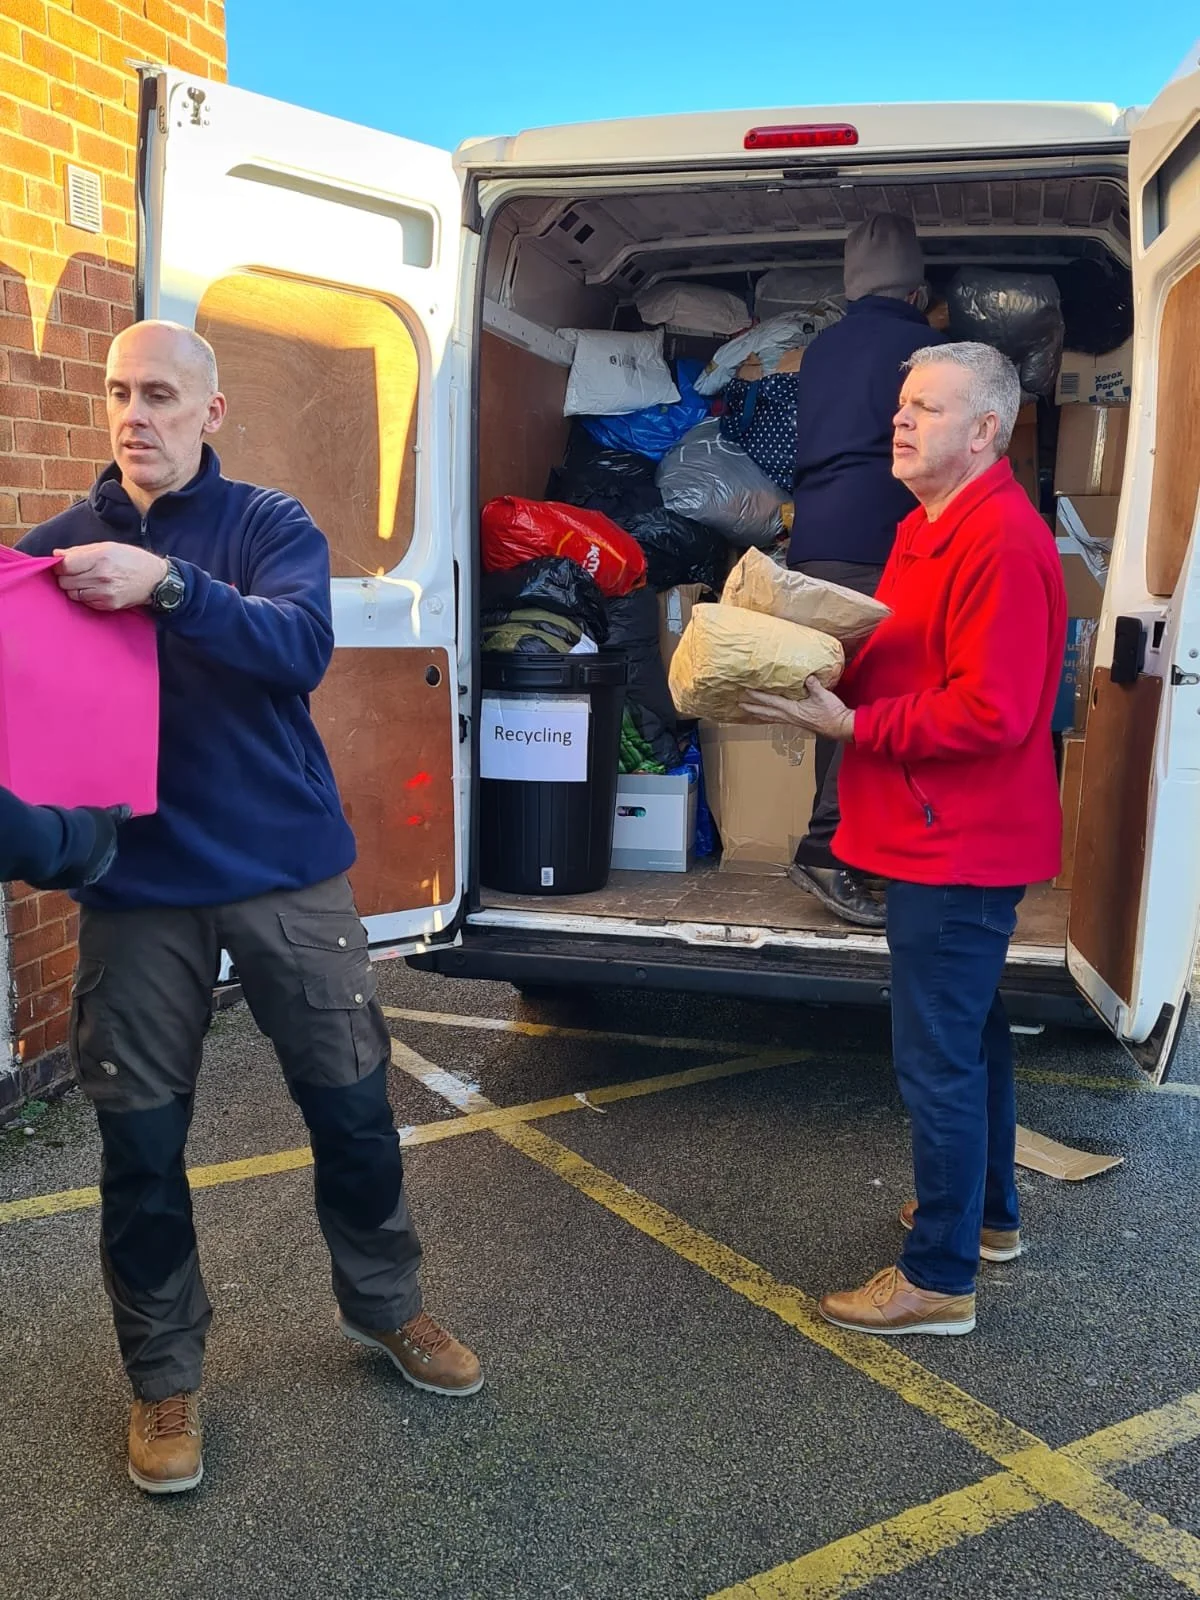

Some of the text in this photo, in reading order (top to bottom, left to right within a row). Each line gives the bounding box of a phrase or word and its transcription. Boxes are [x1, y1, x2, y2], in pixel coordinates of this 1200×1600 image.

[1095, 371, 1122, 384] Xerox
[1095, 379, 1124, 391] Paper
[494, 725, 572, 747] Recycling
